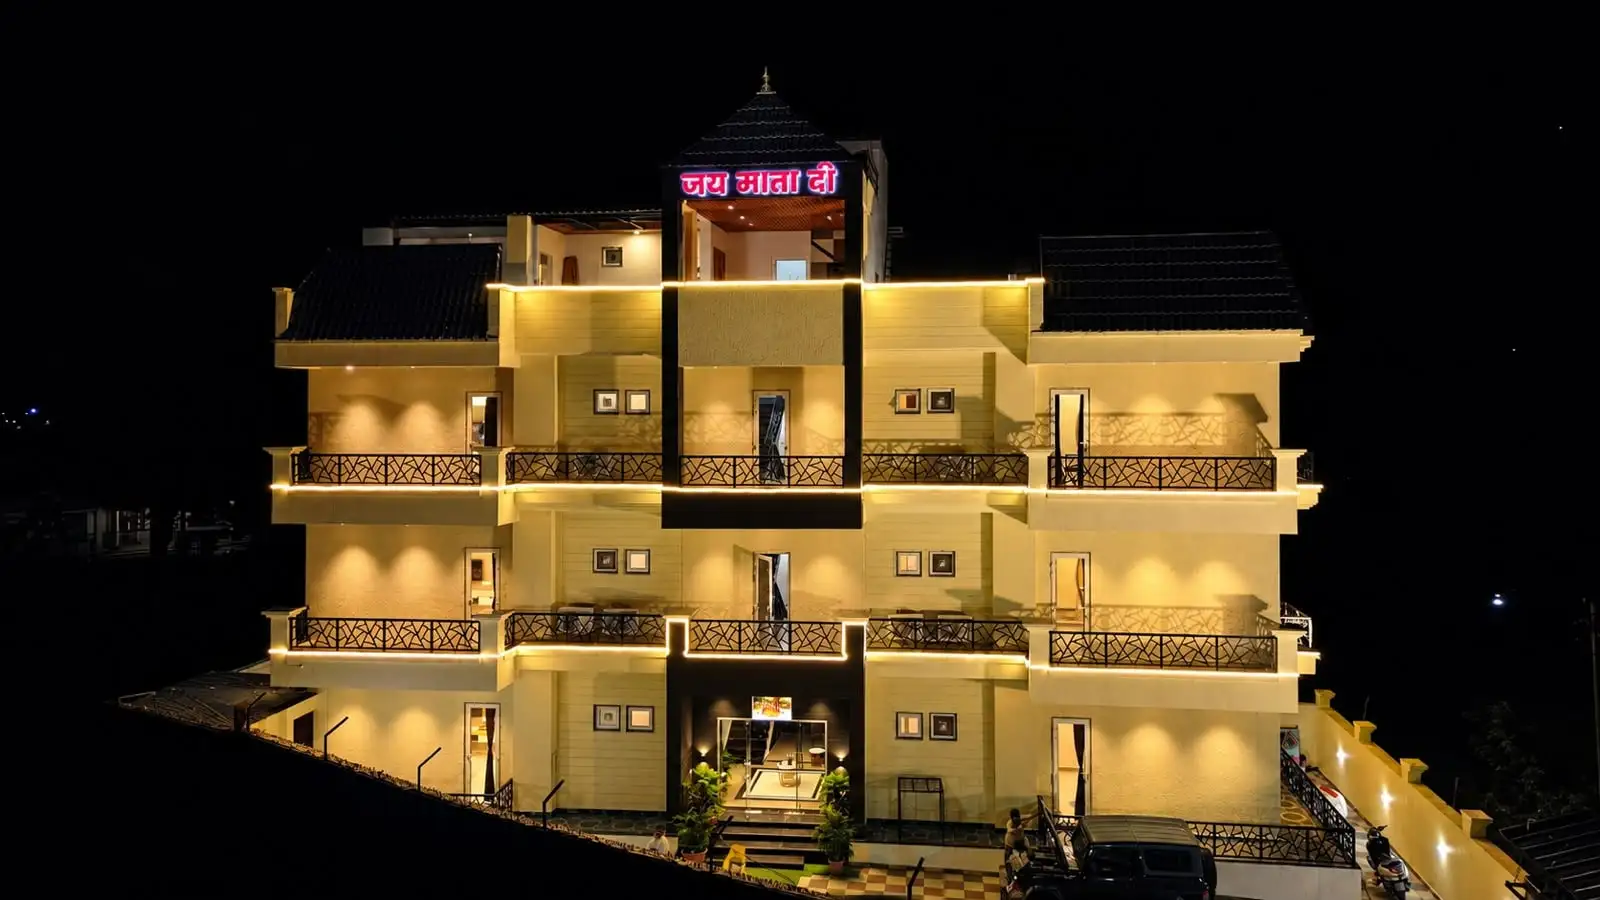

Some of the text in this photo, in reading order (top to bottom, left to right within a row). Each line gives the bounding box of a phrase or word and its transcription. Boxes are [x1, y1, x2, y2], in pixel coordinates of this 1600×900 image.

[680, 161, 838, 197] जय माता दी
